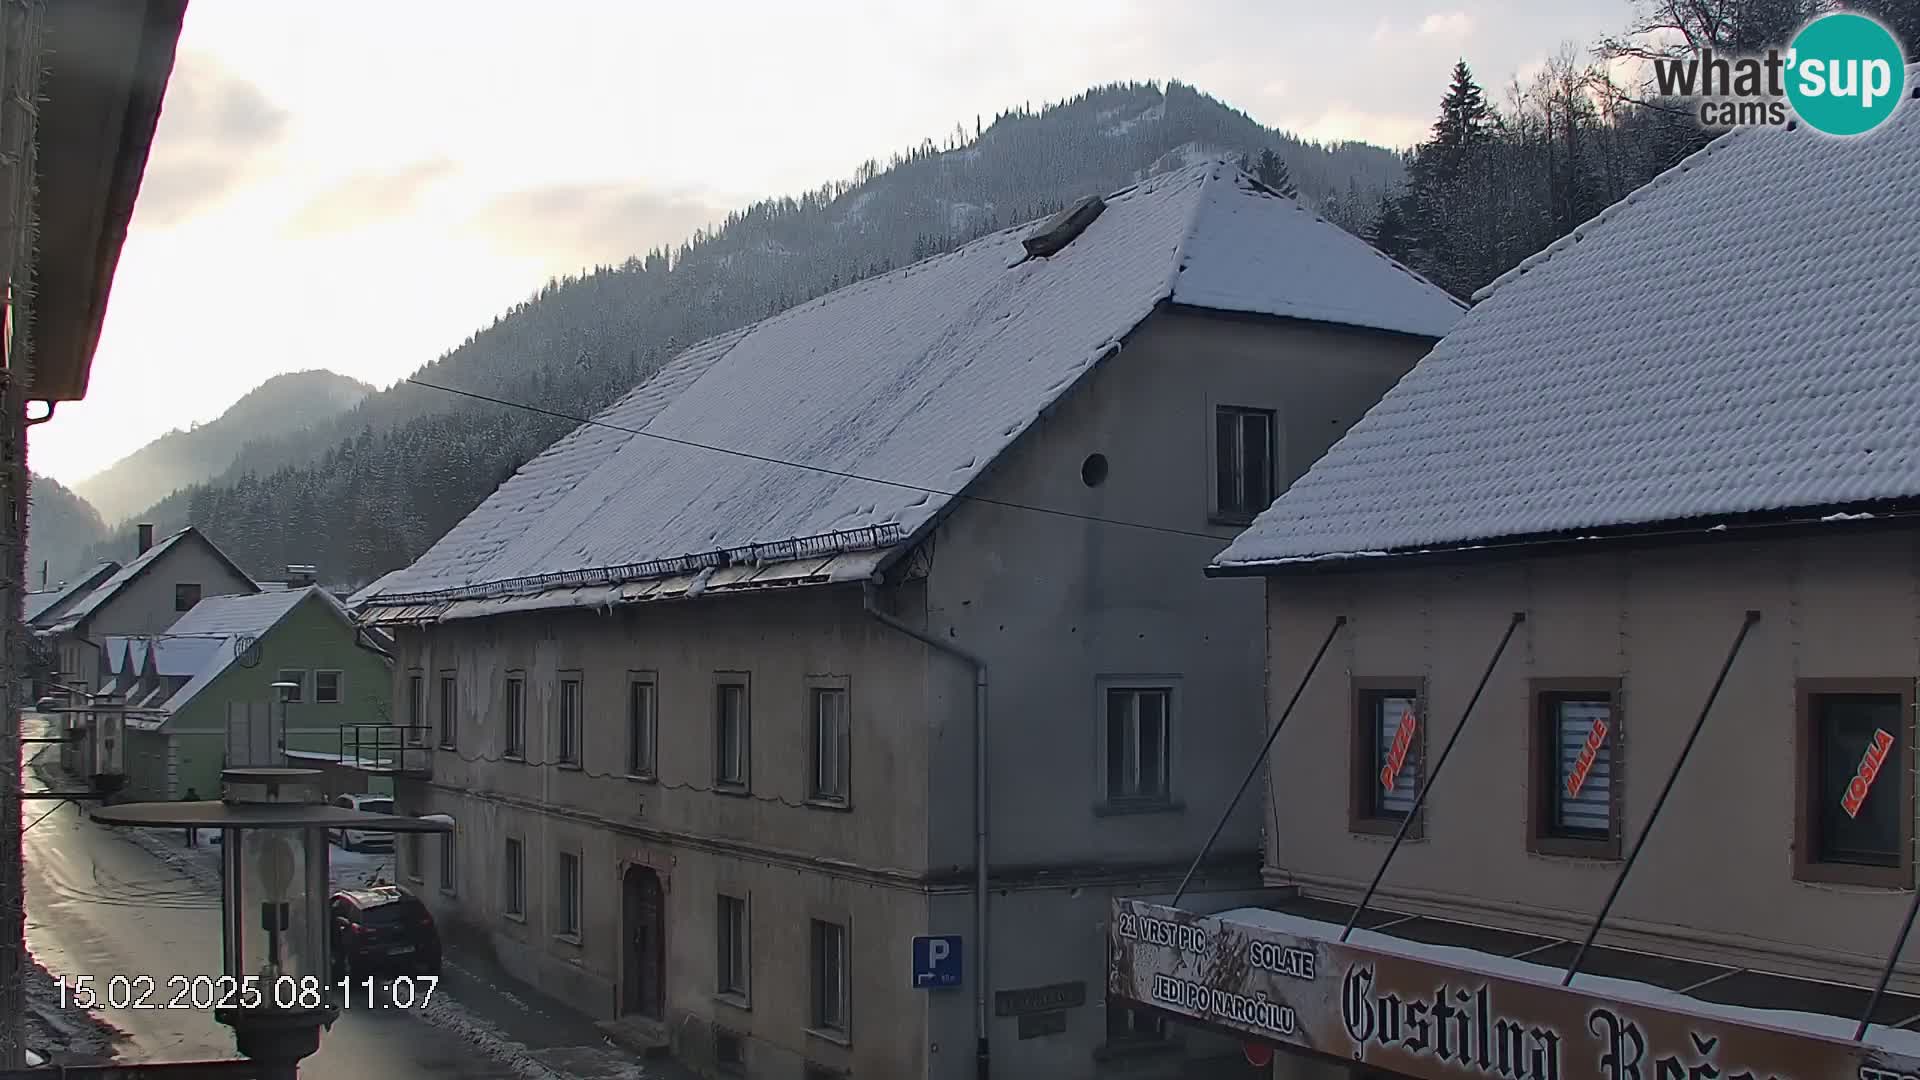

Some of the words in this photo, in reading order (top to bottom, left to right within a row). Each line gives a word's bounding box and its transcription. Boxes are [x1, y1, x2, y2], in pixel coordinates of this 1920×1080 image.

[1567, 718, 1608, 799] MALICE
[1840, 728, 1895, 819] KOSILA
[929, 940, 949, 968] P
[1119, 914, 1138, 938] 21
[1139, 918, 1177, 946] VRST
[1178, 925, 1207, 954] PIC
[1250, 941, 1315, 979] SOLATE
[1152, 975, 1185, 1006] JEDI
[1186, 984, 1210, 1012] PO
[1211, 990, 1295, 1035] NAROČILU
[1342, 962, 1561, 1080] Gostilna
